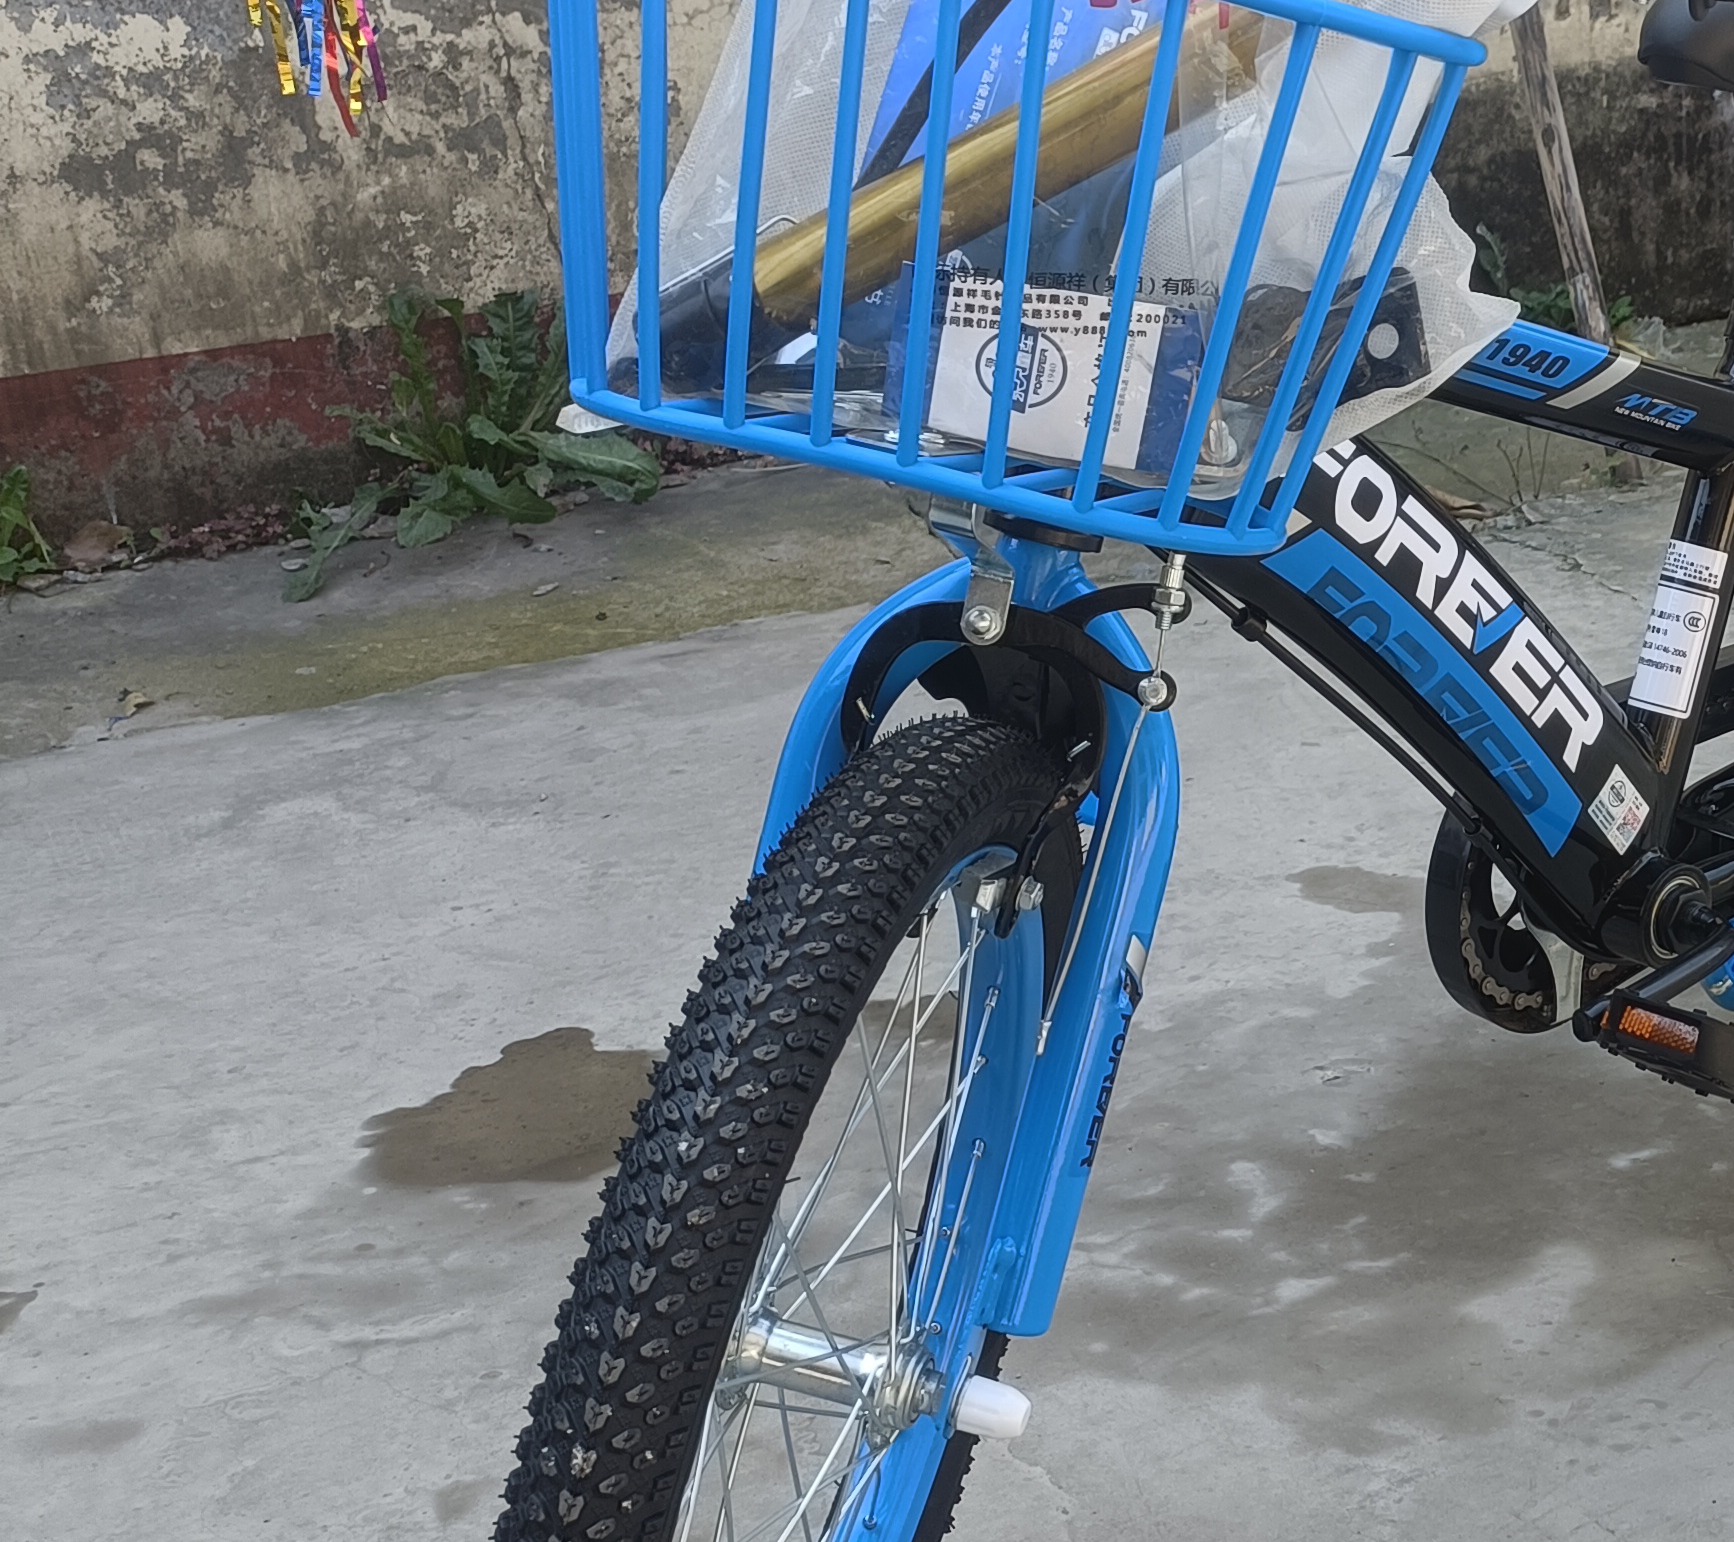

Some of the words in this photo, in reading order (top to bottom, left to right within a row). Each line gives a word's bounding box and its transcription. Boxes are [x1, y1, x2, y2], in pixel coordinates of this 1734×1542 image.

[965, 43, 1003, 131] 本产品使用年
[1046, 362, 1058, 384] 1940
[1486, 337, 1571, 380] 1940
[1616, 394, 1698, 425] MTB
[1631, 411, 1665, 427] MOUNTAIN
[1665, 421, 1682, 431] BIKE
